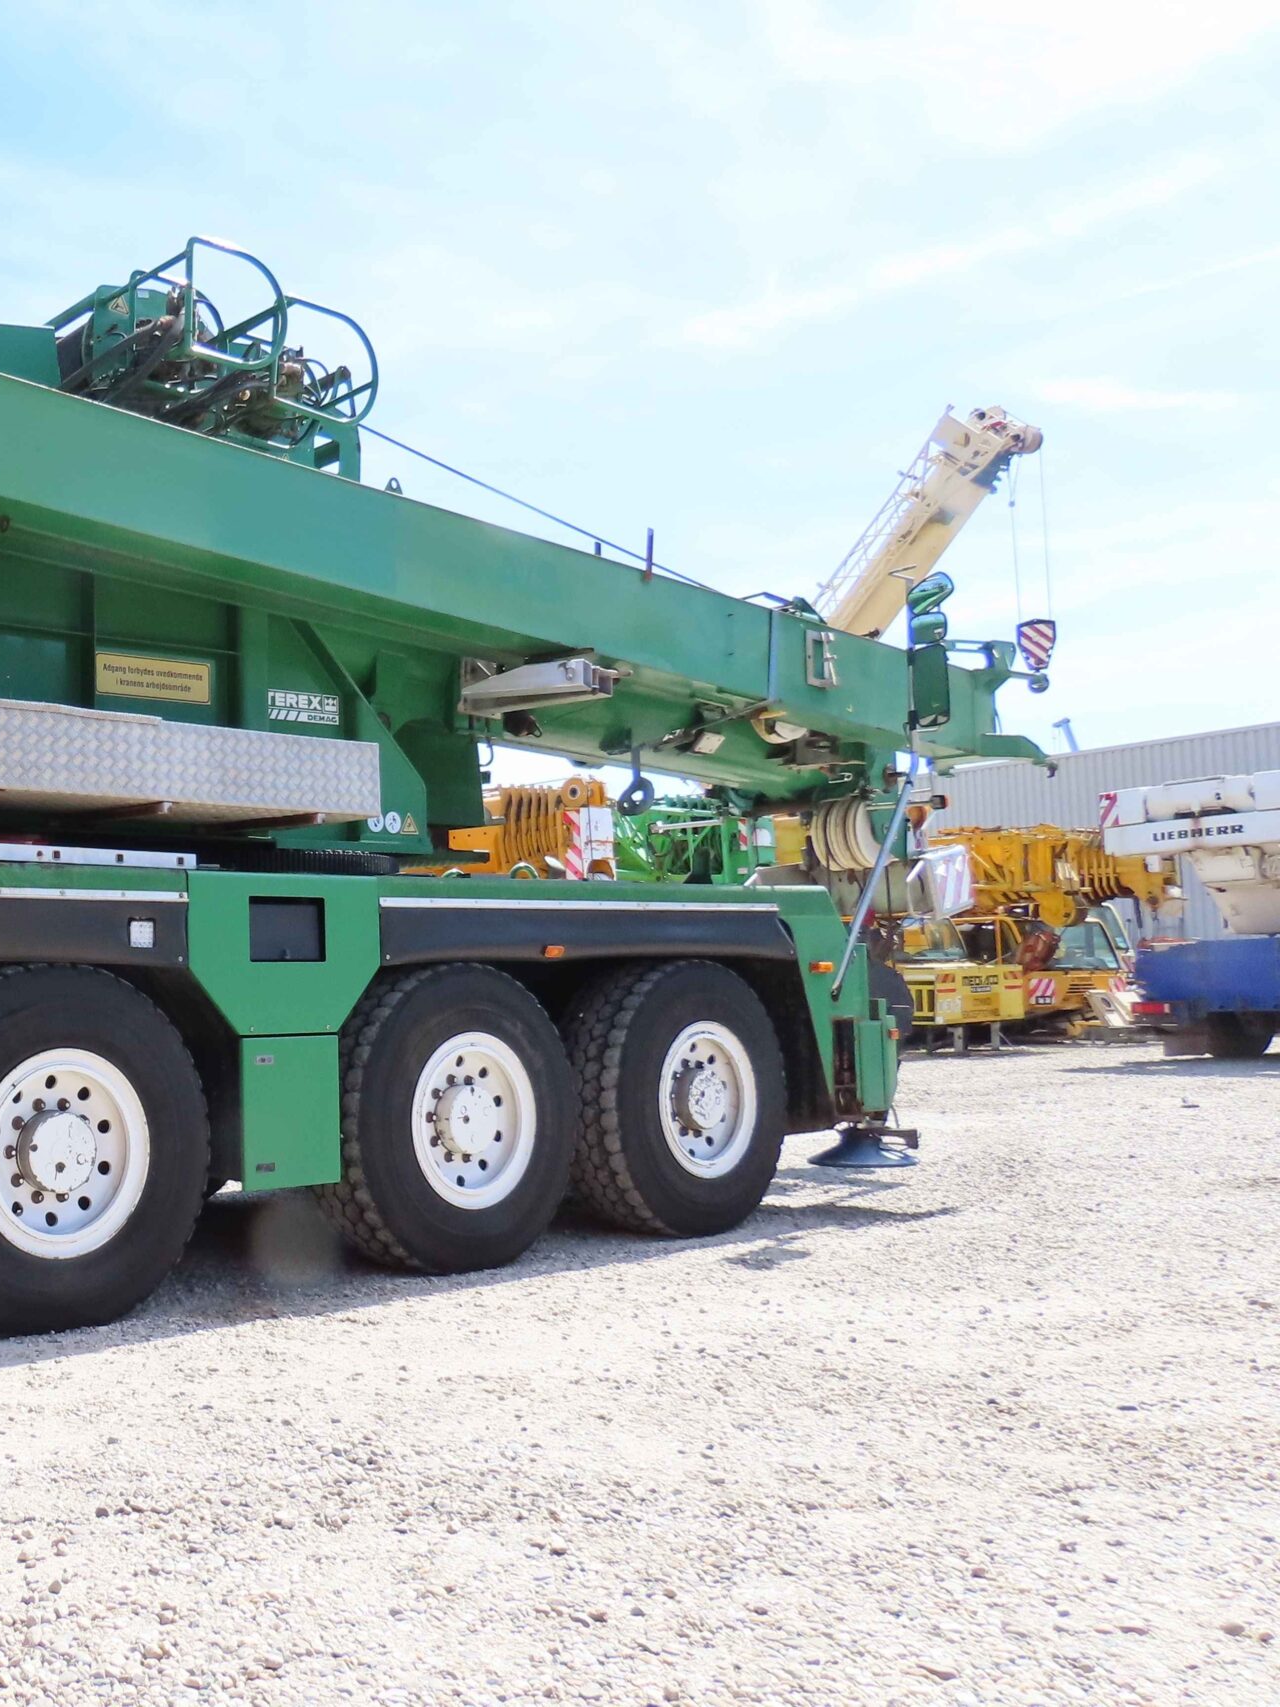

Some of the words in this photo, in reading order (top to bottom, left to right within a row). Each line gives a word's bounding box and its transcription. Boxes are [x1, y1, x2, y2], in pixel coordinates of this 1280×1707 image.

[103, 663, 127, 674] Adgang
[128, 666, 154, 677] forbydes
[156, 670, 203, 681] uvedkommende
[120, 678, 145, 688] kranens
[268, 691, 321, 711] TEREX
[307, 714, 337, 724] DEMAG
[1152, 824, 1244, 841] LIEBHERR
